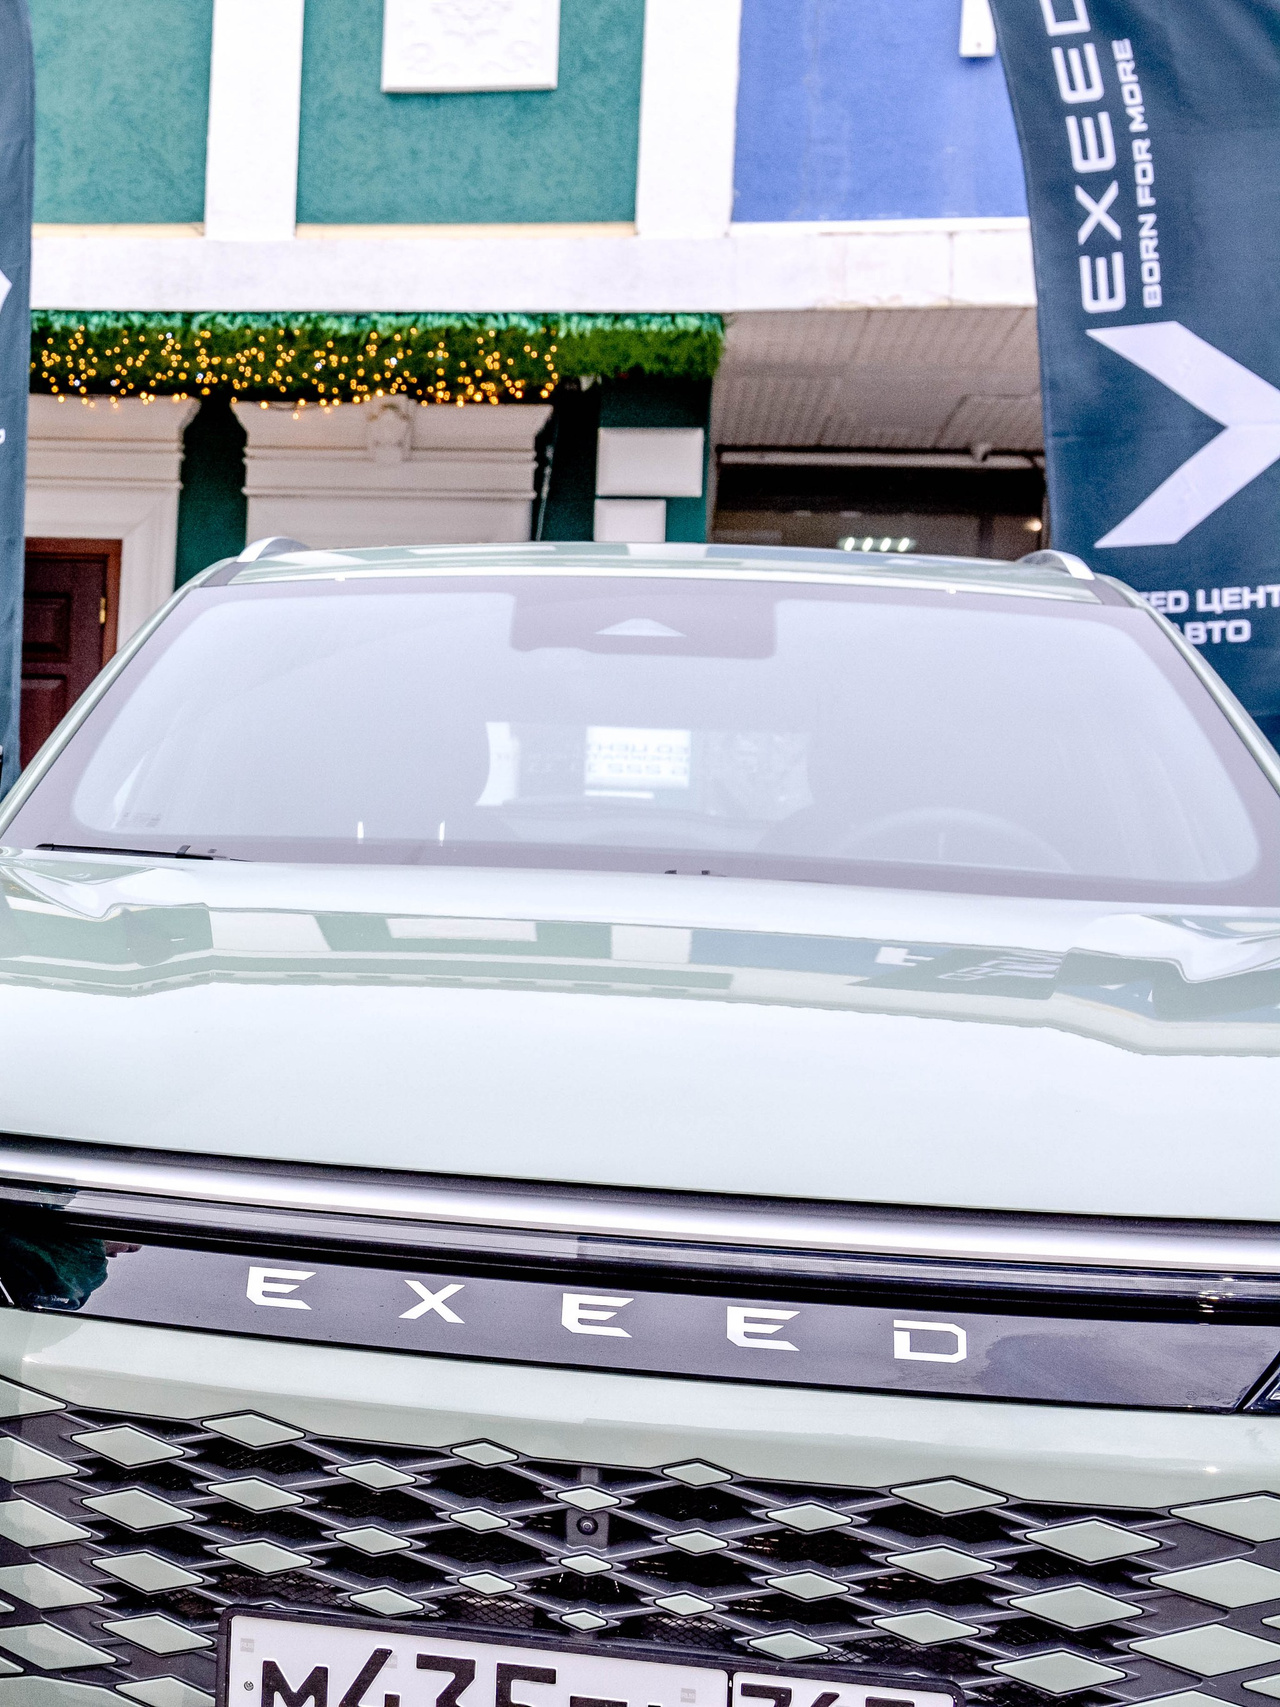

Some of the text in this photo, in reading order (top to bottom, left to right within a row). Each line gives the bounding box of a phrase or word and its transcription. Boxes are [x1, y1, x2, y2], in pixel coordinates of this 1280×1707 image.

[1111, 38, 1163, 309] BORN FOR MORE
[1172, 619, 1252, 646] ВТО
[244, 1265, 969, 1364] EXEED
